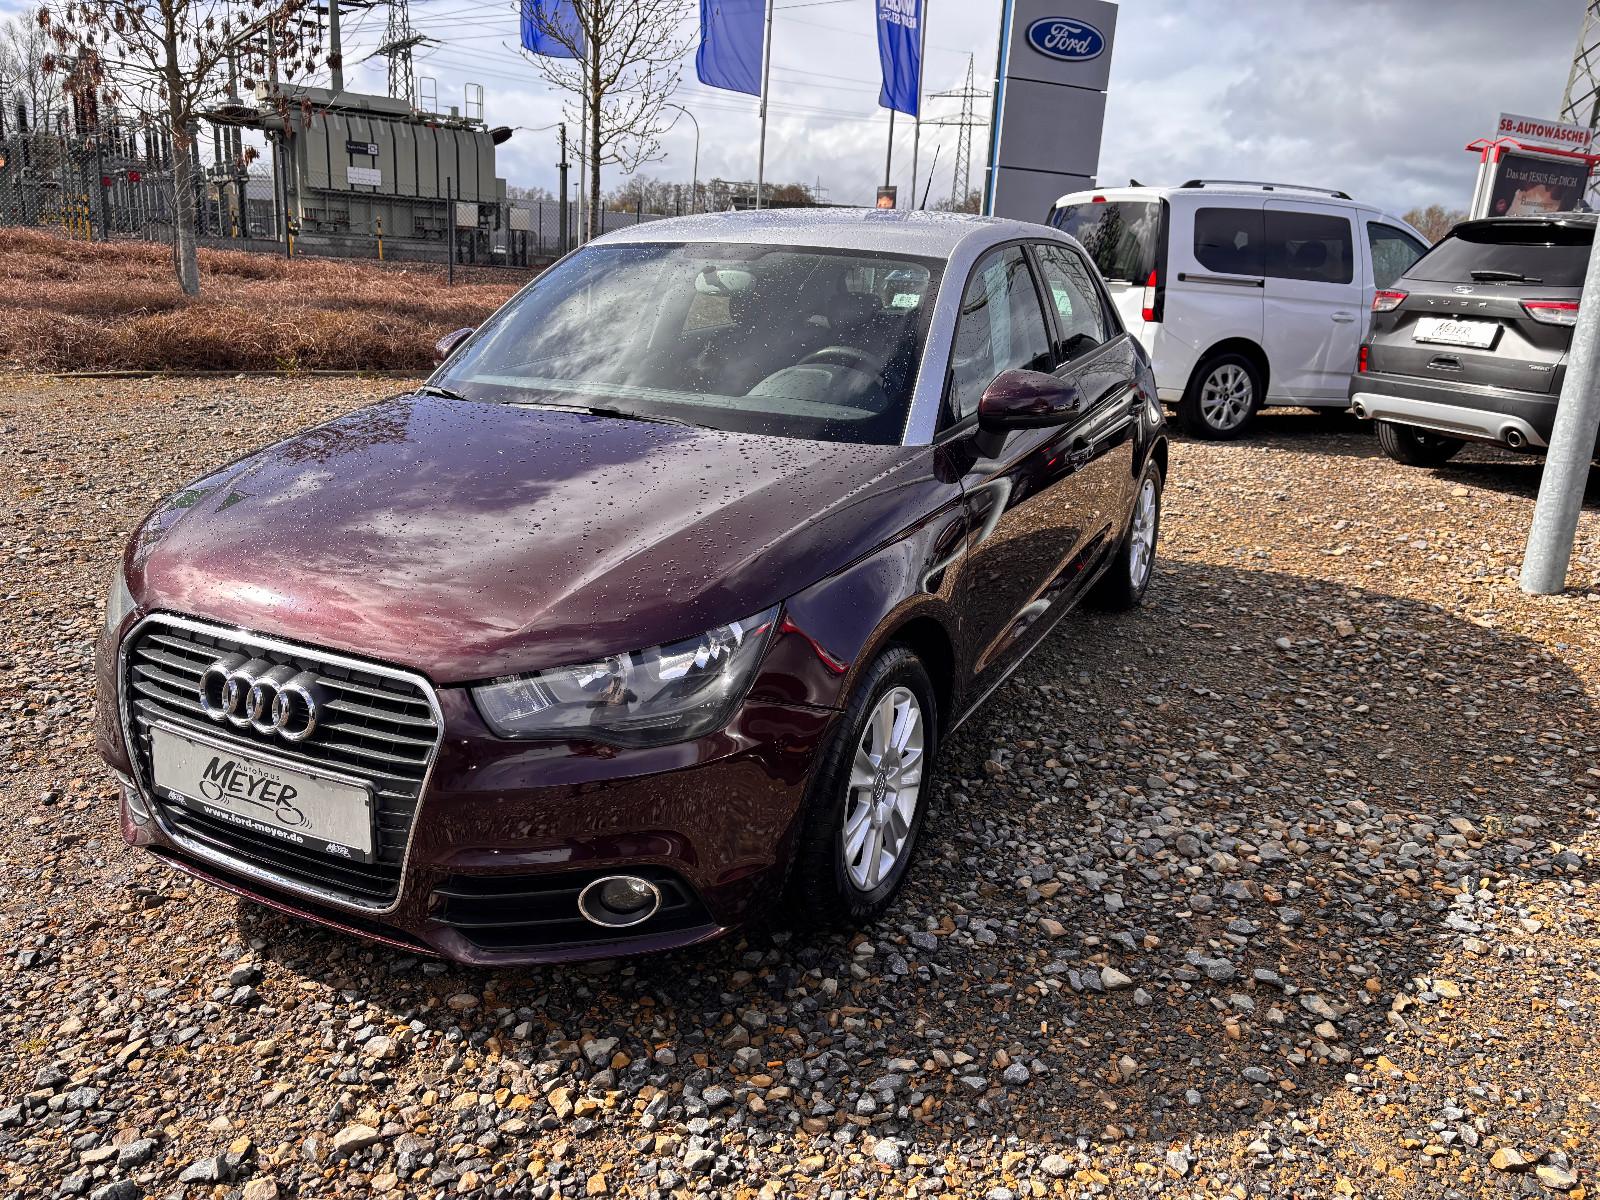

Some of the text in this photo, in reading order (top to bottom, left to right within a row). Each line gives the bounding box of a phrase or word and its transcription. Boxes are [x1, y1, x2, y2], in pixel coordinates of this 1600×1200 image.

[1044, 23, 1092, 54] Ford
[1500, 118, 1584, 143] SB-AUTOWÄSCHE
[1505, 167, 1519, 179] Das
[1528, 171, 1548, 183] JESUS
[1548, 174, 1558, 185] für
[1558, 175, 1578, 187] DICH
[203, 756, 298, 808] MEYER
[235, 762, 280, 781] Autohaus
[203, 805, 304, 843] www.ford-meyer.de
